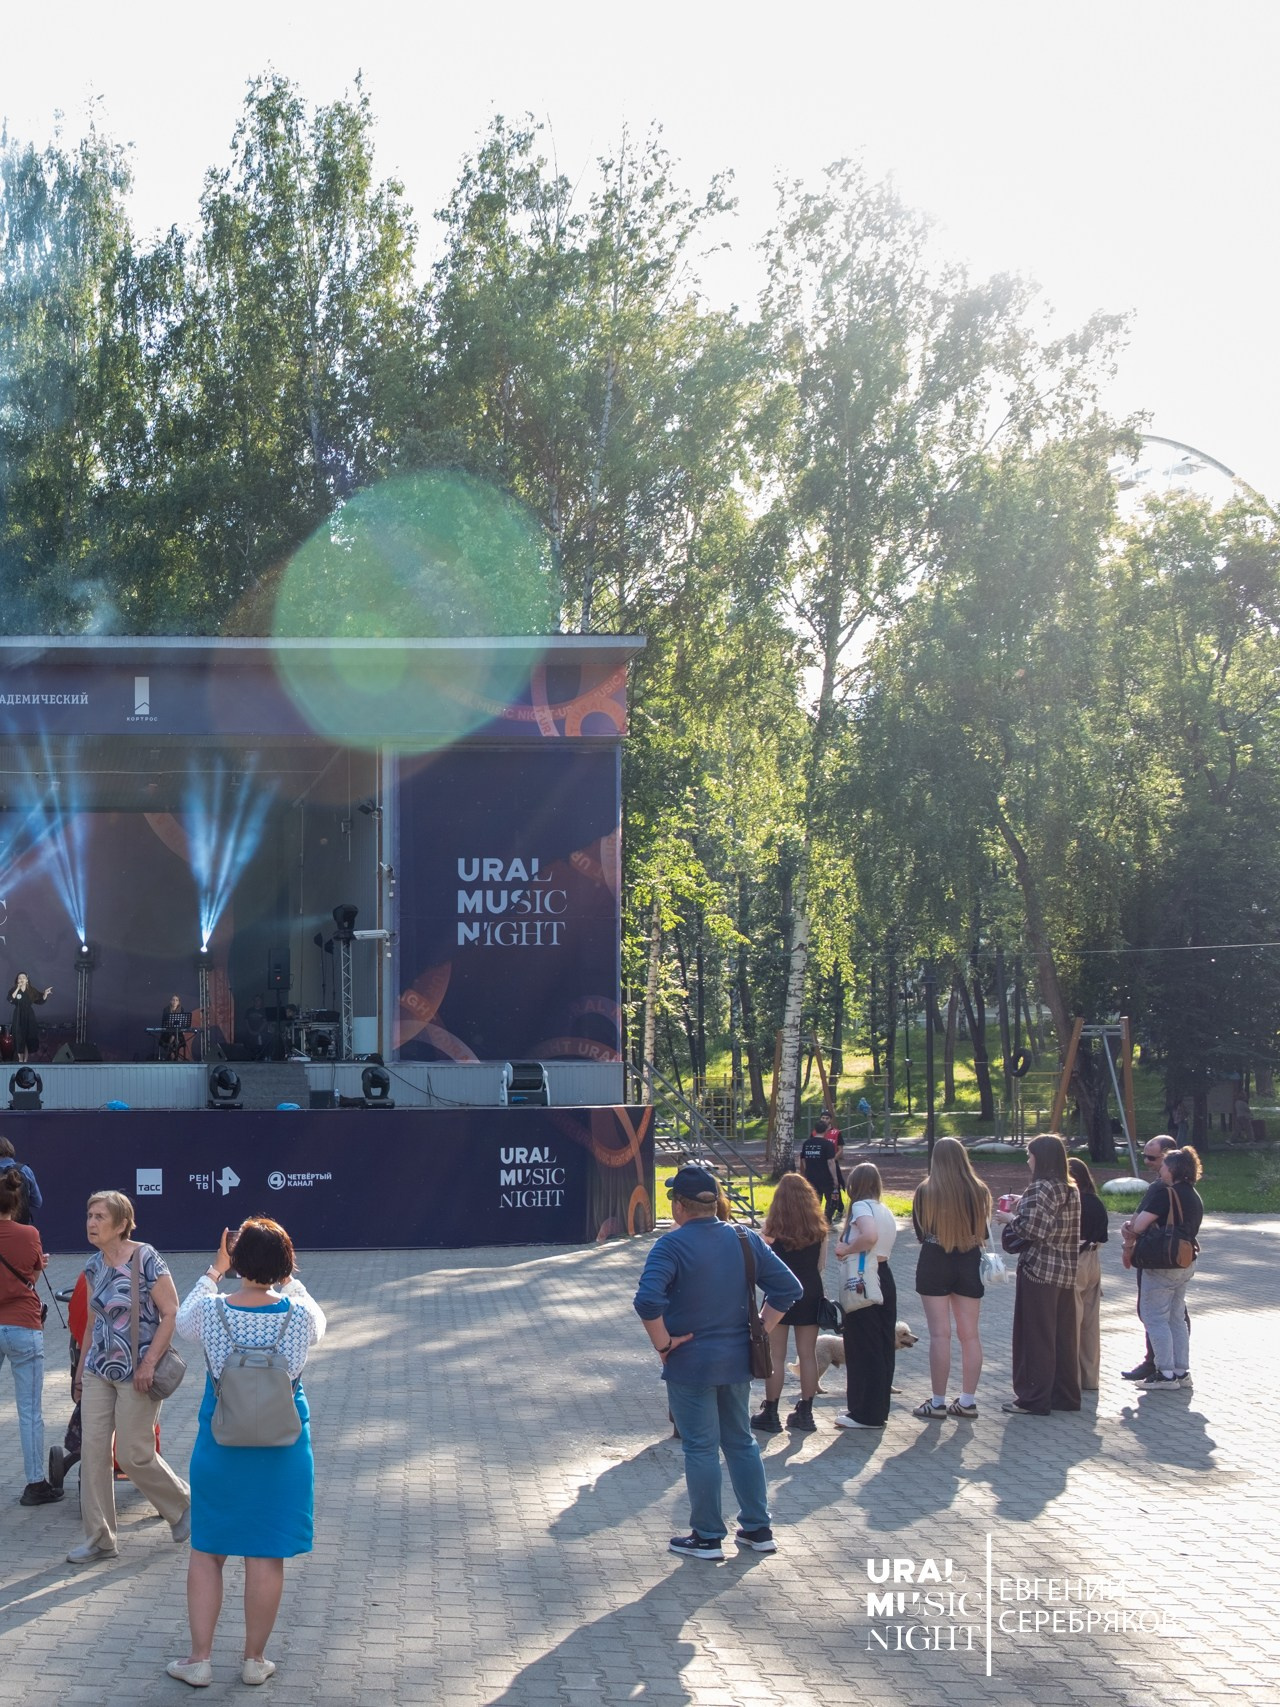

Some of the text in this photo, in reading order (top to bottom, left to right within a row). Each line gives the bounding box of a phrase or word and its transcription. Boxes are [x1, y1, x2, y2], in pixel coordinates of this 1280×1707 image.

[457, 858, 553, 882] URAL
[457, 889, 568, 914] MUSIC
[457, 921, 566, 946] NIGHT
[500, 1147, 557, 1164] URAL
[189, 1174, 209, 1182] РЕН
[287, 1172, 332, 1180] ЧЕТВЁРТЫЙ
[500, 1167, 566, 1186] MUSIC
[196, 1182, 209, 1190] ТВ
[499, 1189, 565, 1208] NIGHT
